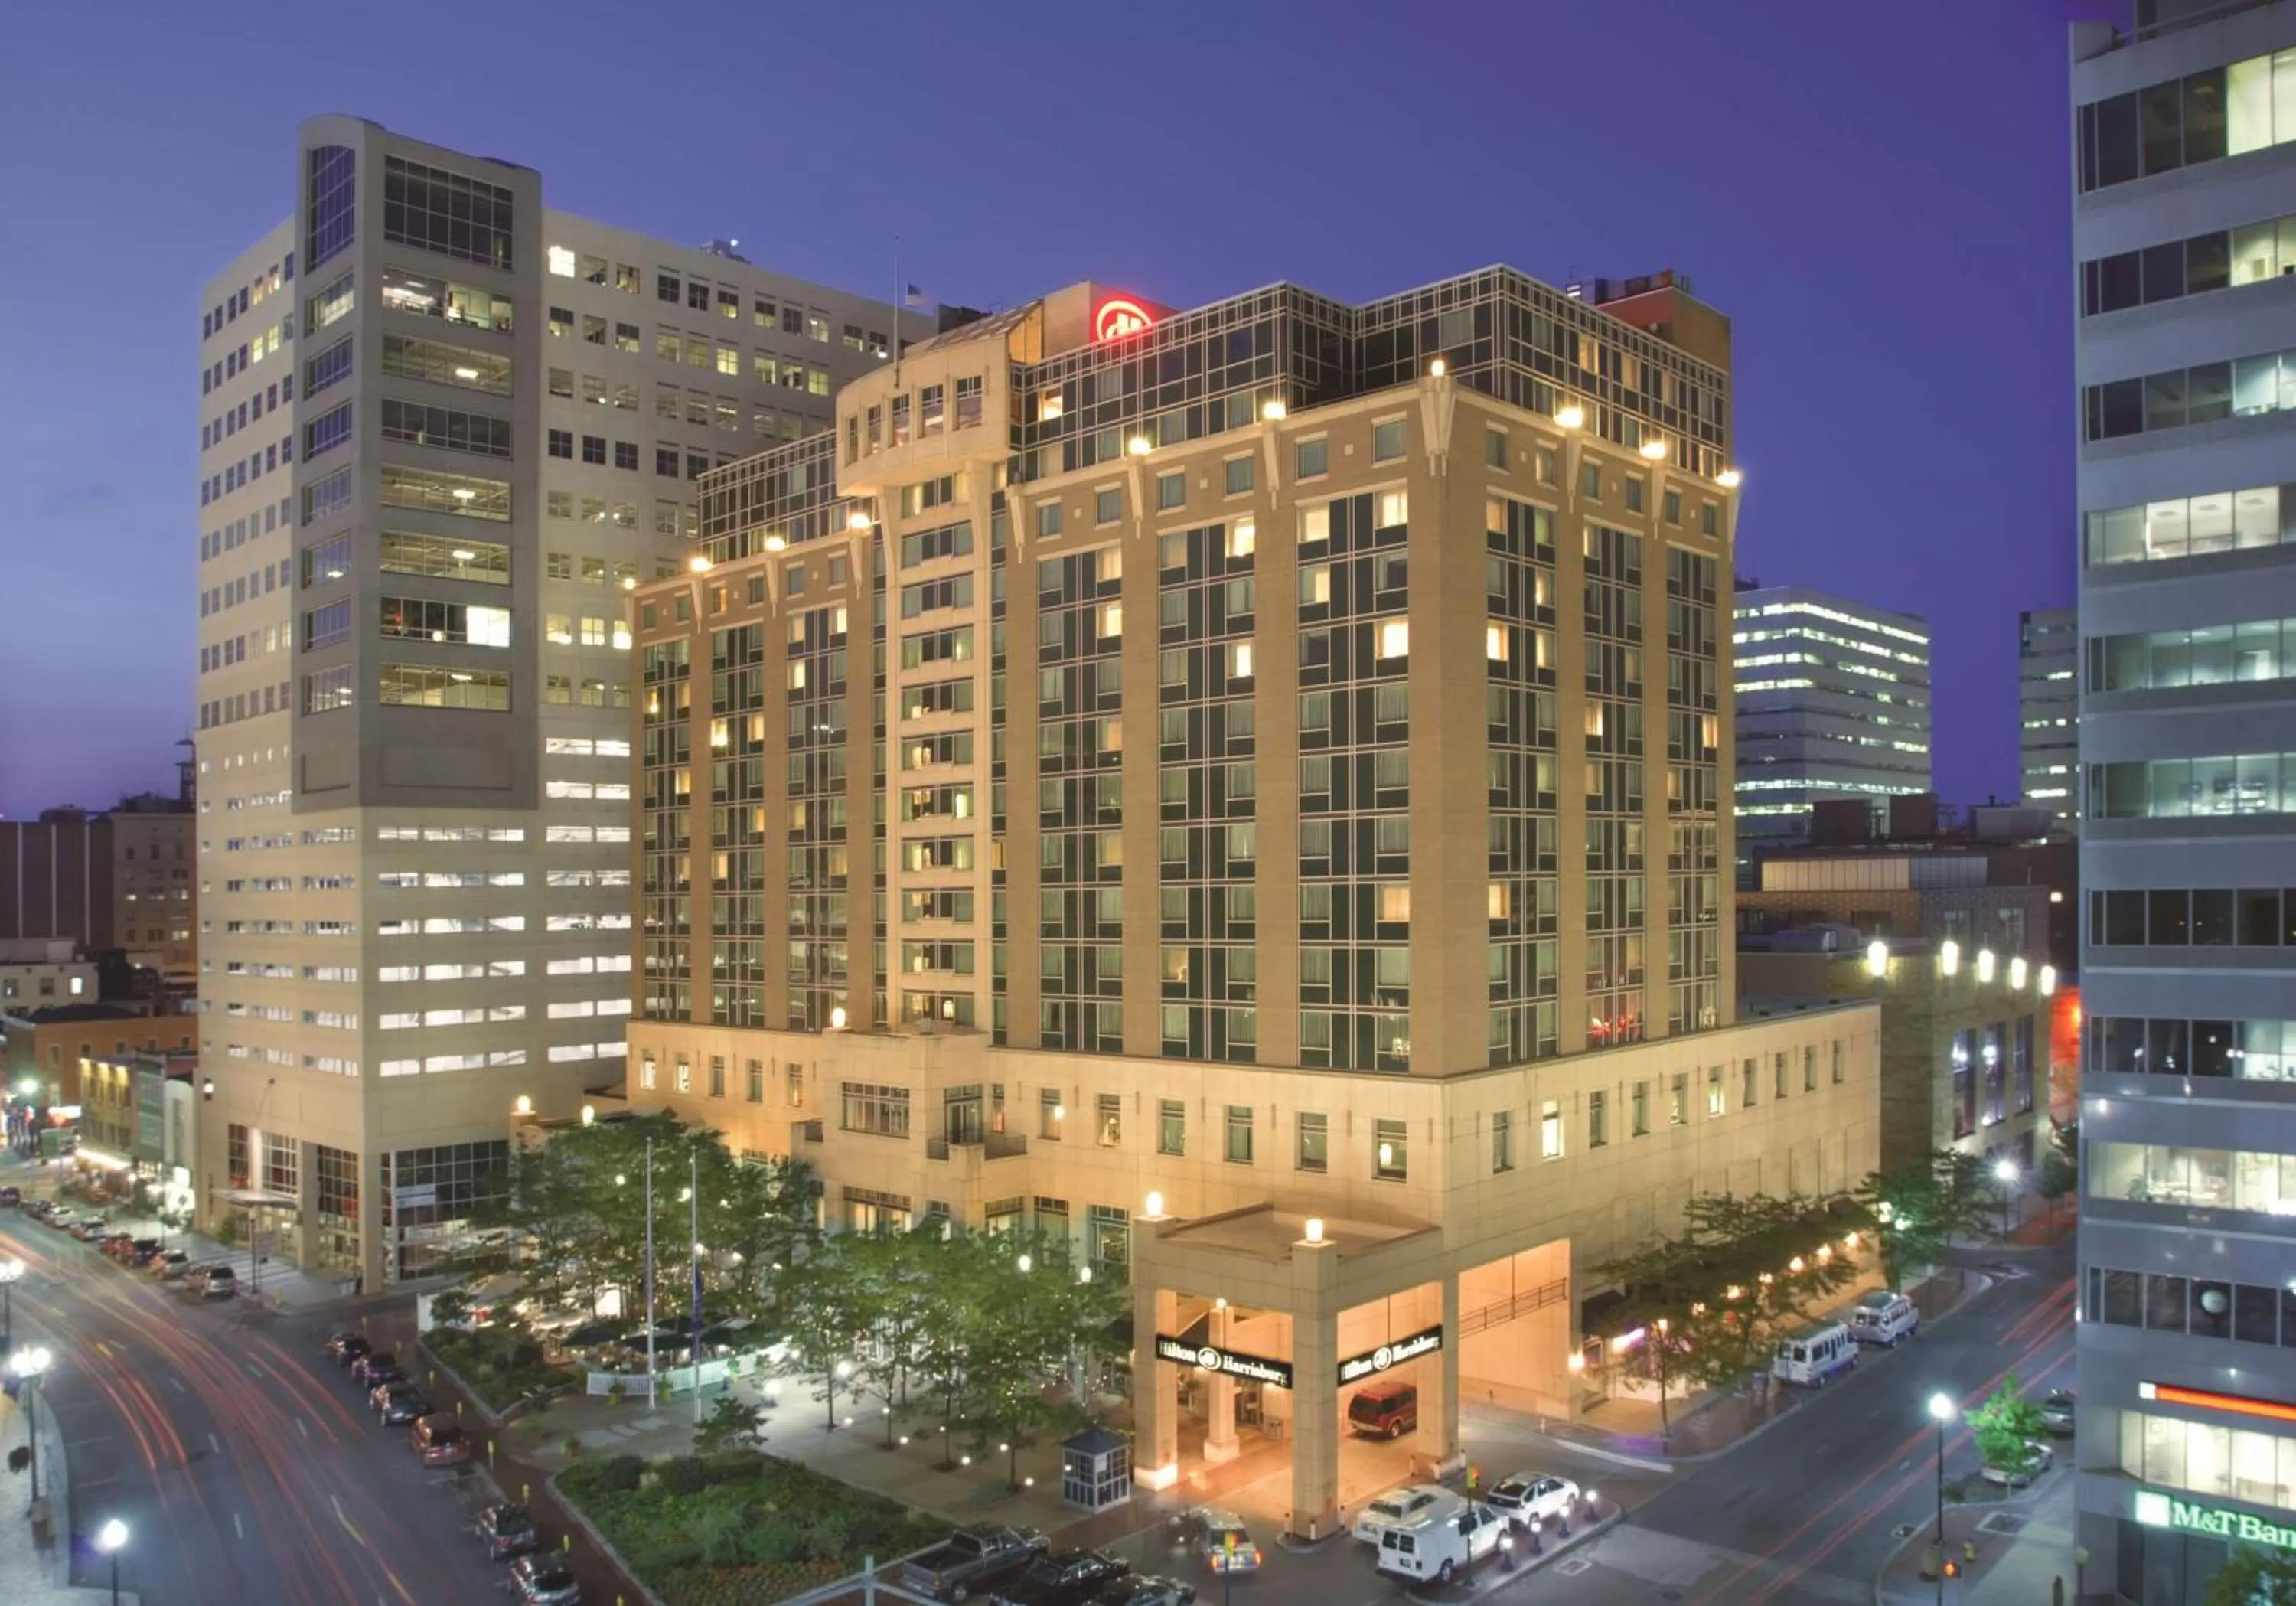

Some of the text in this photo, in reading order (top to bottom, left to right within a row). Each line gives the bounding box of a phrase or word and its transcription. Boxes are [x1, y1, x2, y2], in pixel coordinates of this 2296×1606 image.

[1159, 1341, 1288, 1386] Hilton Harrisburg
[2173, 1502, 2237, 1535] M&T
